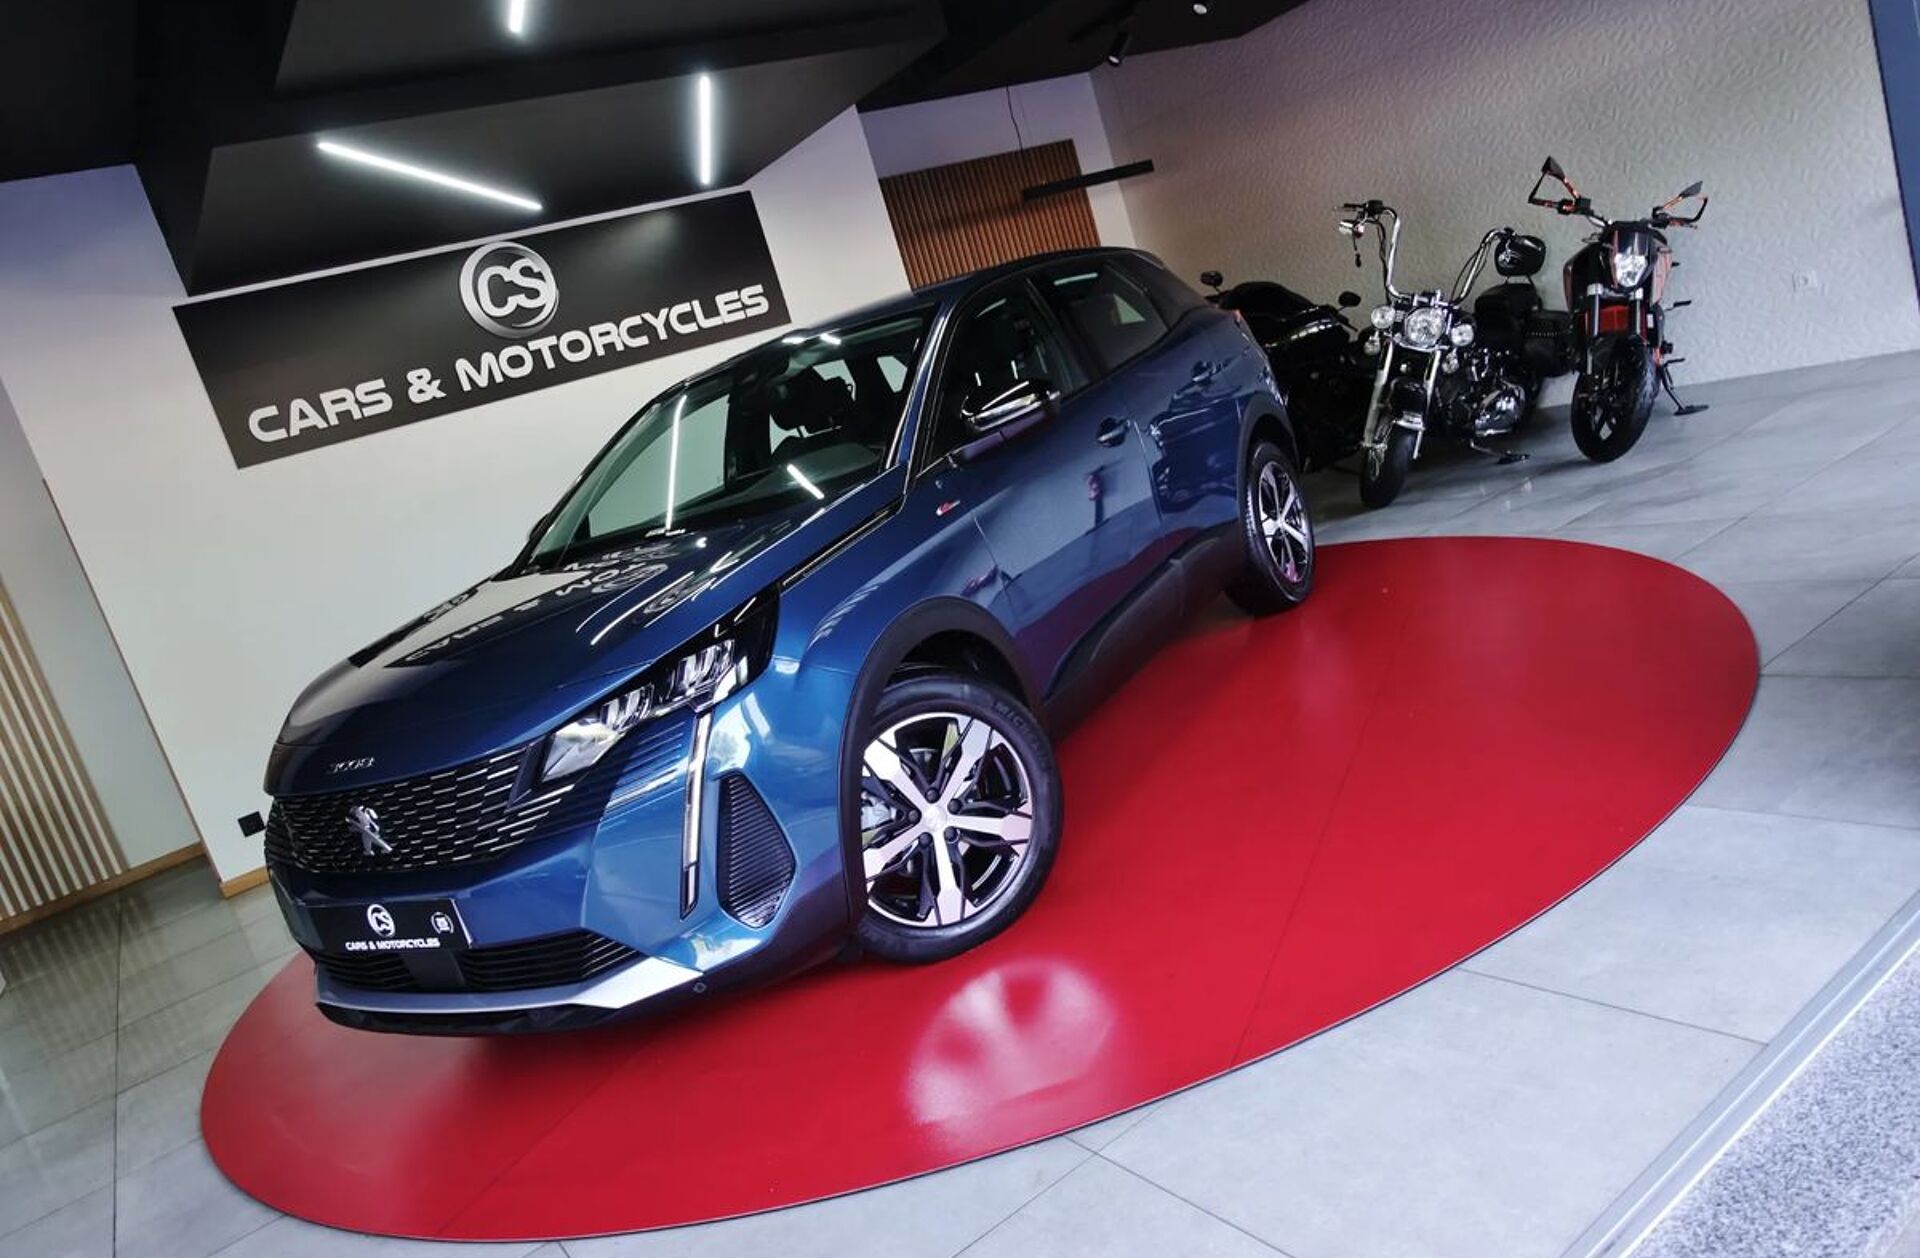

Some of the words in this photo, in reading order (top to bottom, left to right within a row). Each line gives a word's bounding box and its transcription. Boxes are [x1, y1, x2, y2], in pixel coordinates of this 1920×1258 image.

[477, 257, 549, 318] CS
[248, 378, 394, 443] CARS
[406, 361, 447, 404] &
[455, 284, 770, 392] MOTORCYCLES
